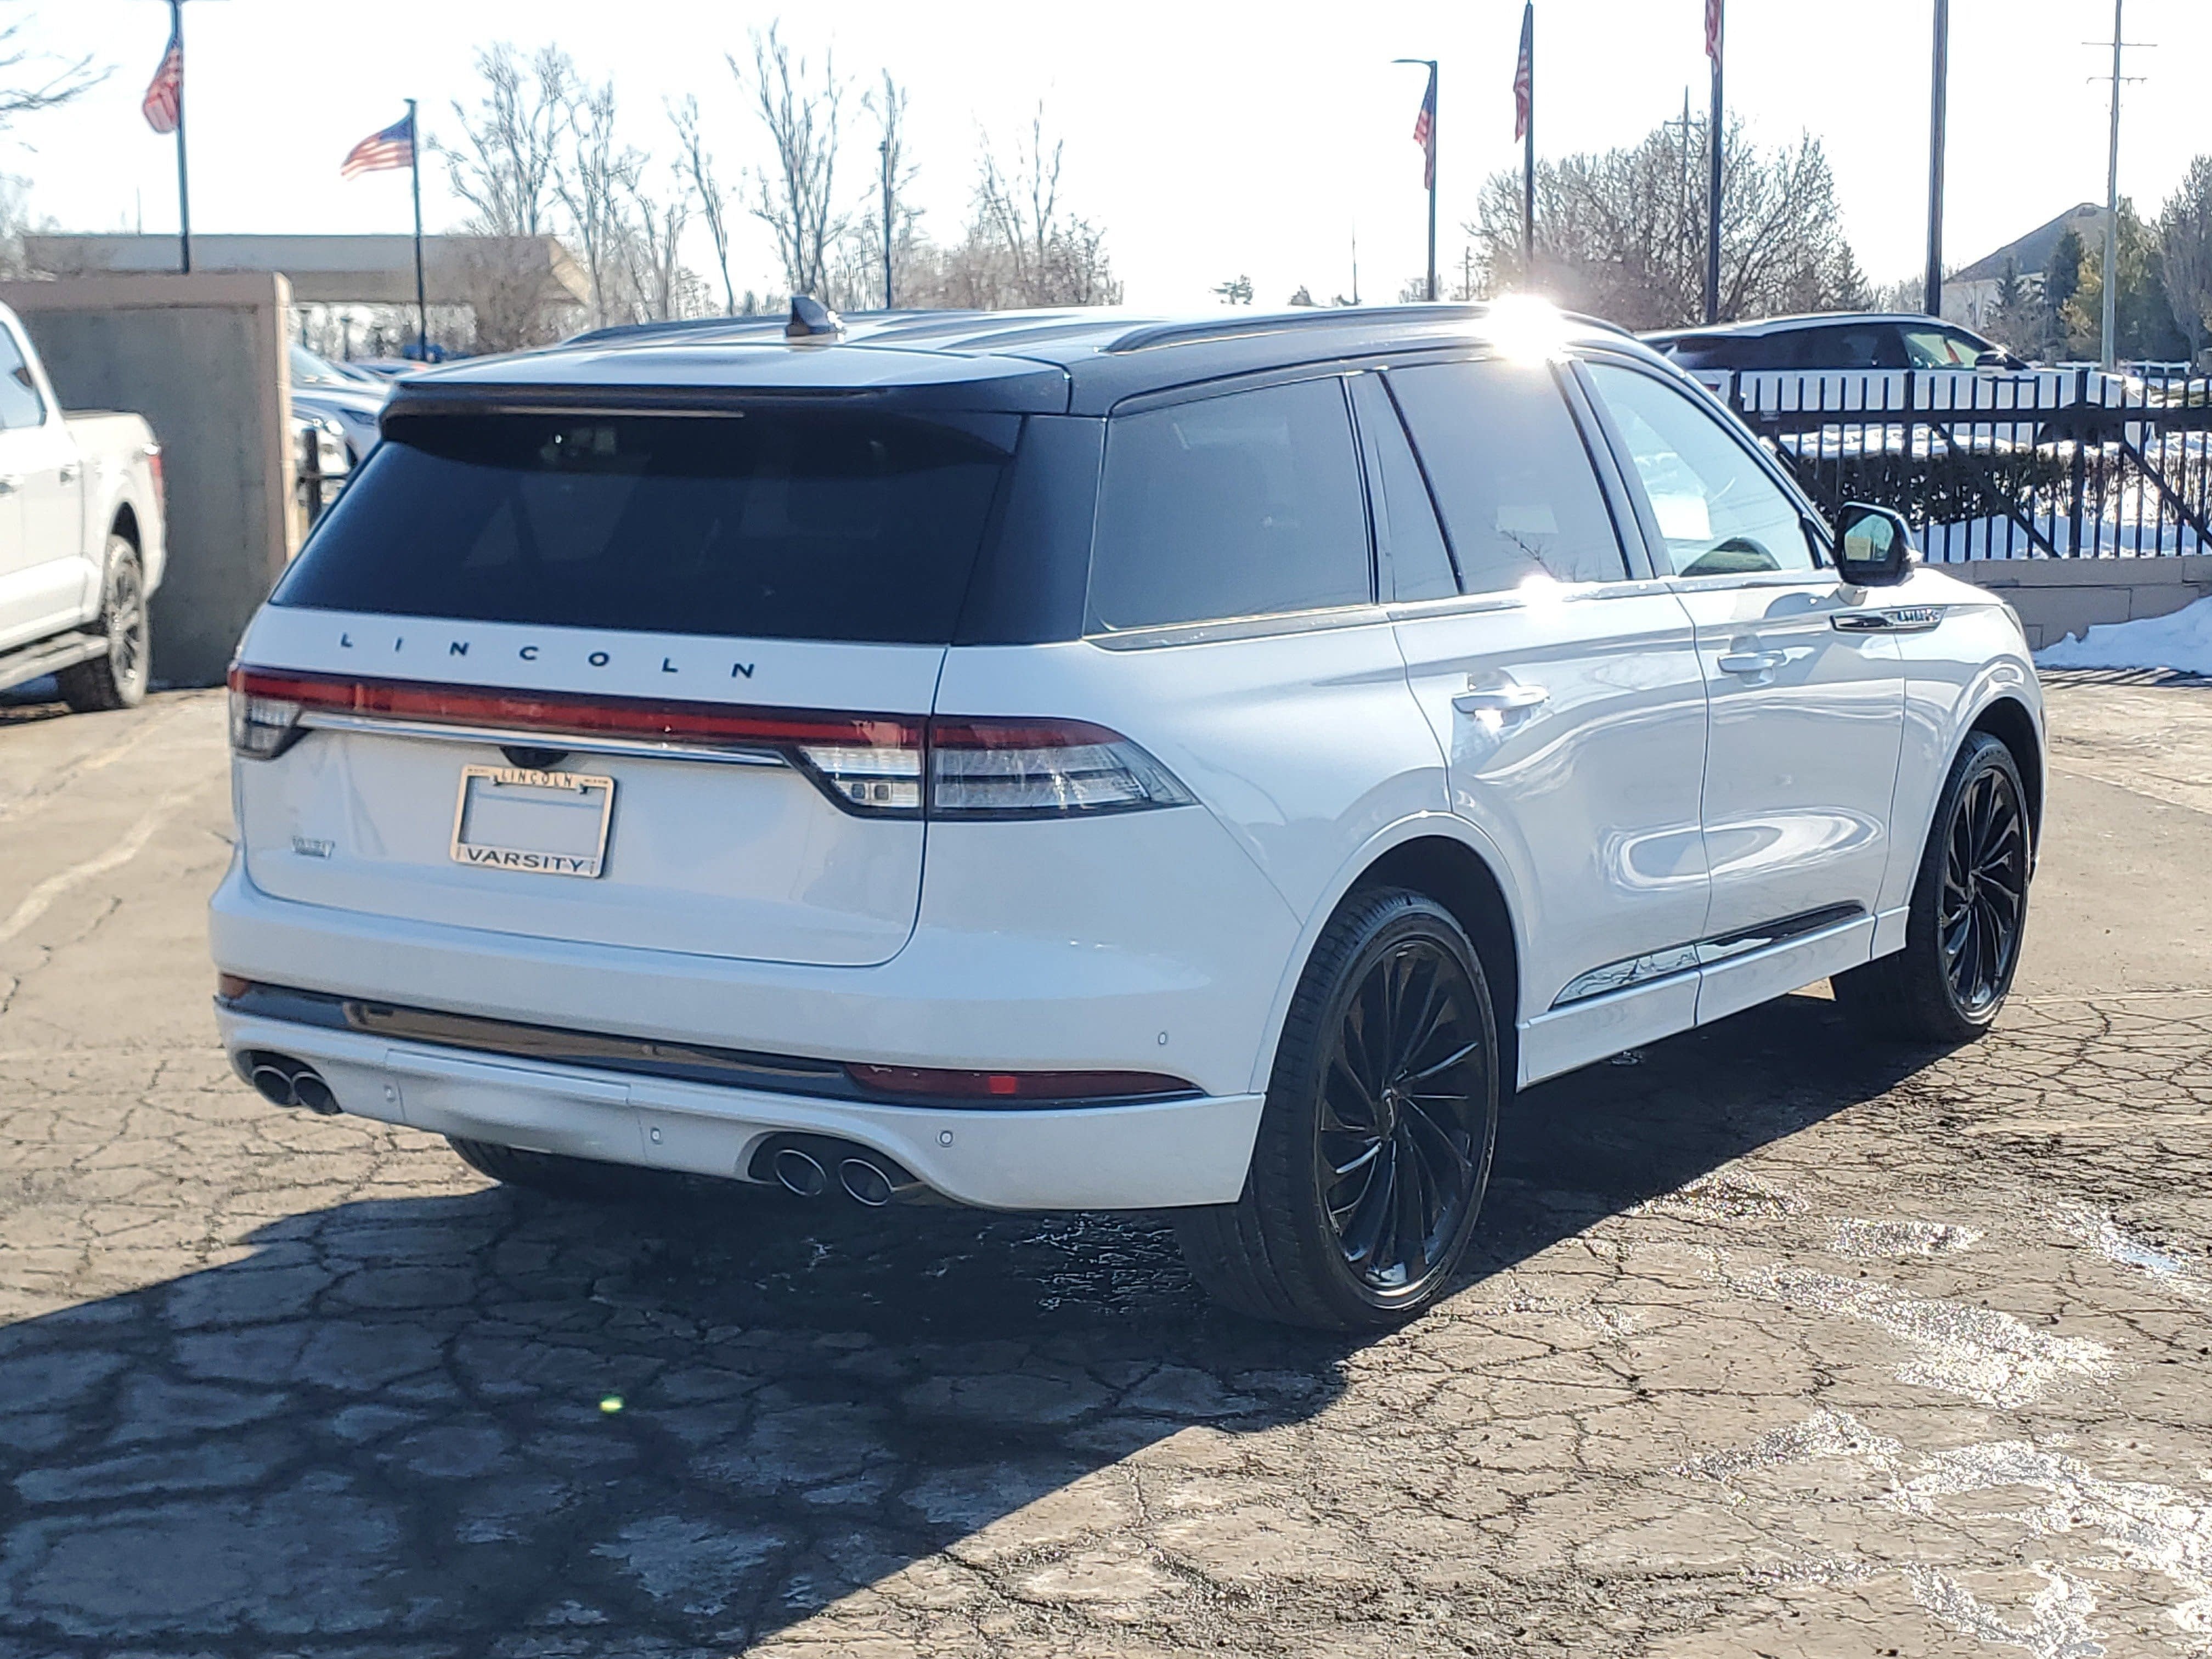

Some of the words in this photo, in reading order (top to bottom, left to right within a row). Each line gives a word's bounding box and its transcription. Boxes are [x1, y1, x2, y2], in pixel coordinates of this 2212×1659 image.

[338, 633, 755, 679] LINCOLN
[501, 768, 572, 787] LINCOLN
[467, 847, 585, 872] VARSITY
